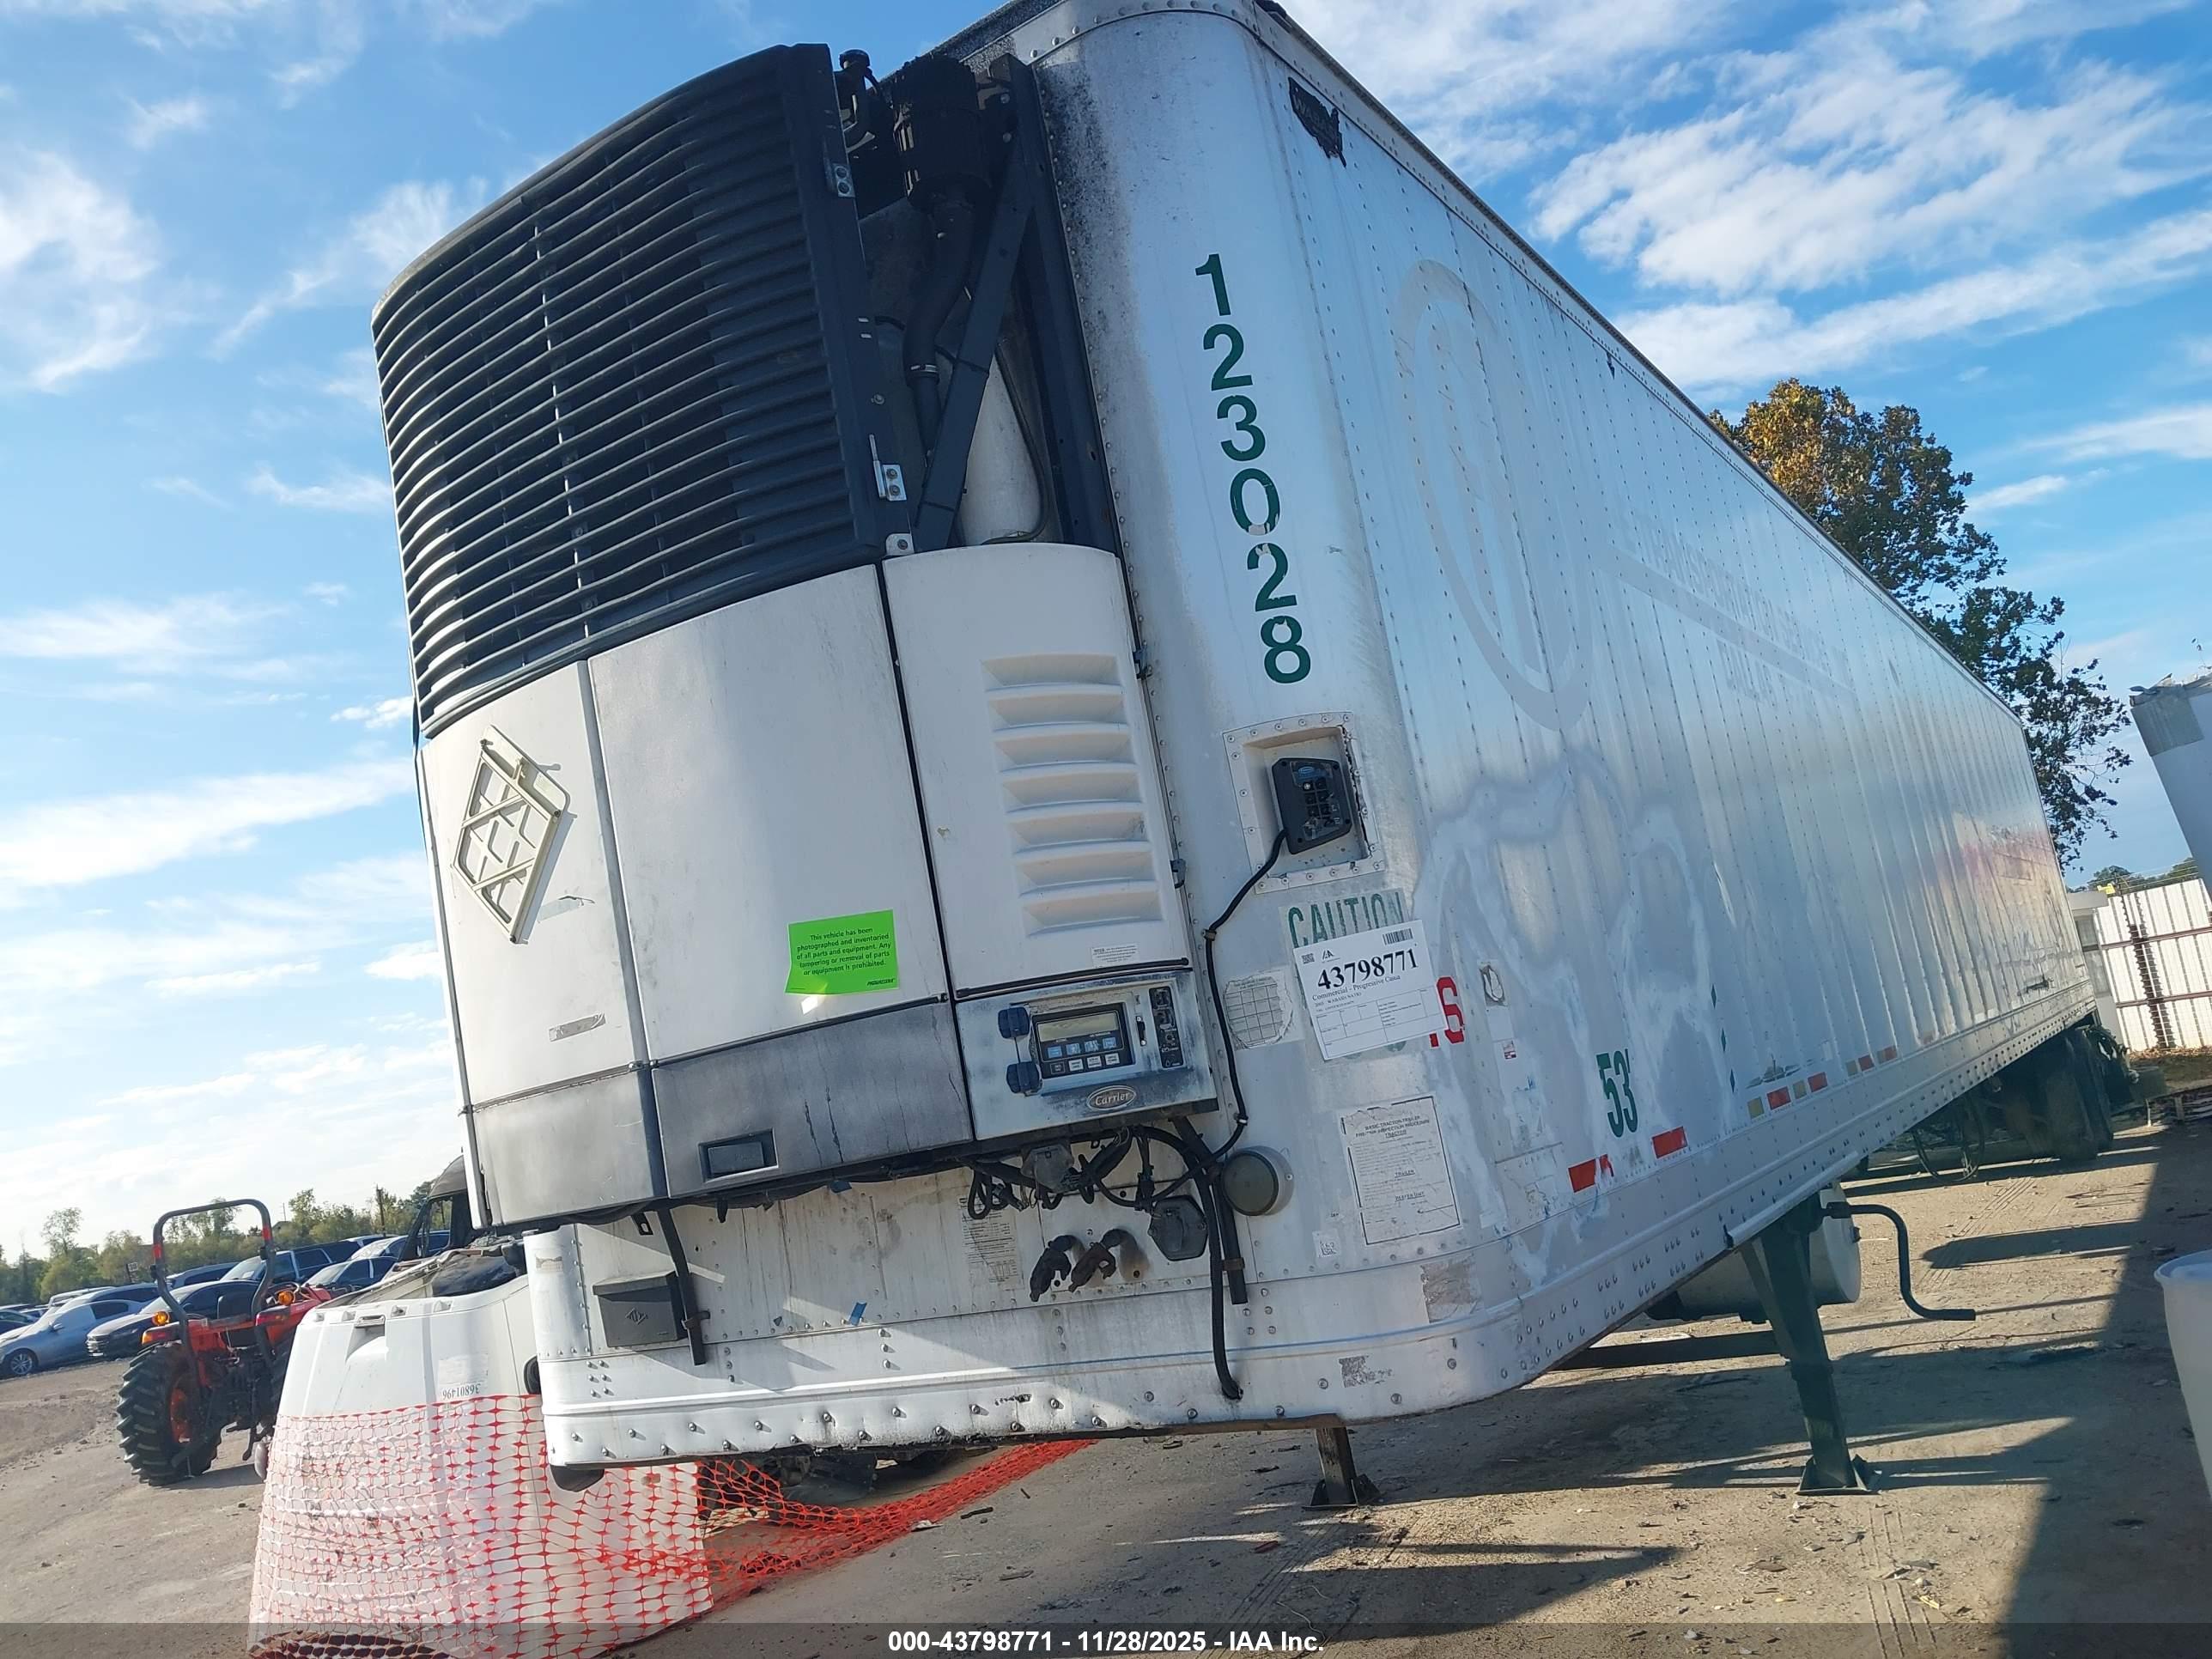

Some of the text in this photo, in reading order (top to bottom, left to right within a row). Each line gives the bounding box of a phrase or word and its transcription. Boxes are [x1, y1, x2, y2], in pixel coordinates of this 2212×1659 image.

[1195, 253, 1311, 684] 123028
[797, 940, 839, 952] photographed
[854, 933, 890, 944] inventoried
[799, 959, 830, 968] tampering
[839, 954, 864, 963] removal
[873, 951, 890, 959] parts
[812, 950, 828, 959] parts
[812, 966, 844, 975] equipment
[1318, 948, 1419, 989] 43798771
[1312, 987, 1348, 1001] Commercial
[1353, 979, 1384, 992] Progressive
[1095, 1091, 1129, 1106] Carrier
